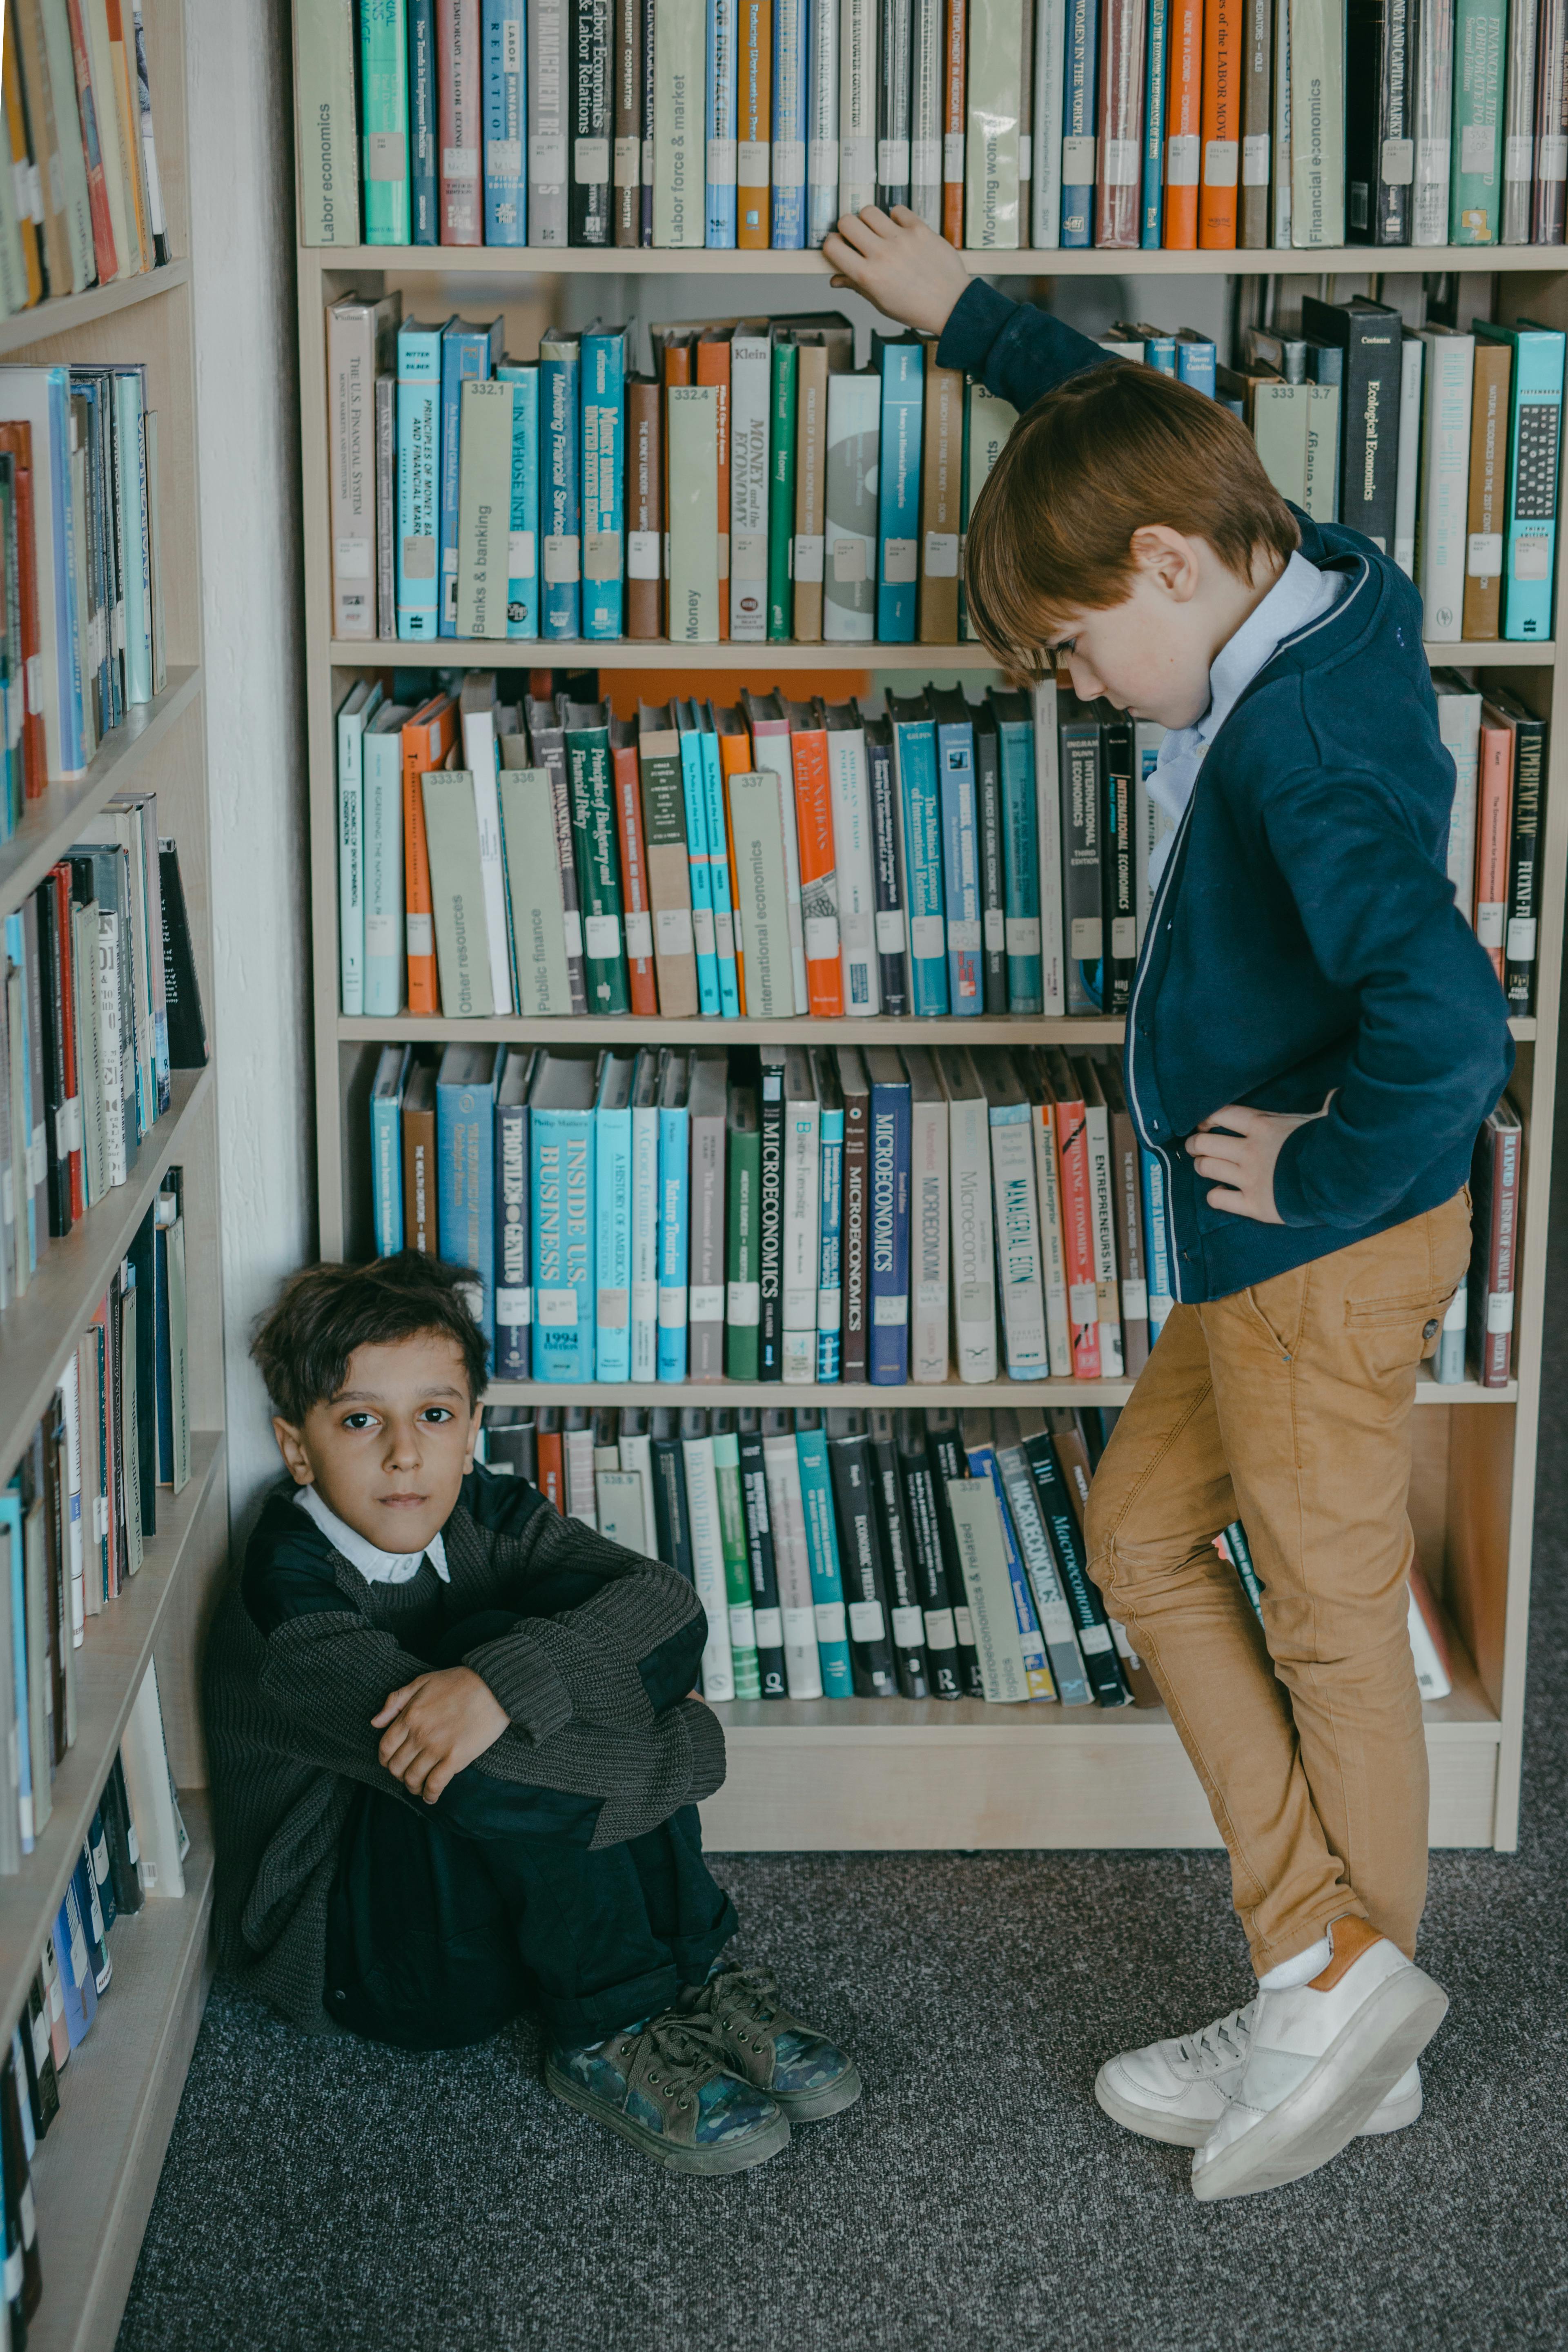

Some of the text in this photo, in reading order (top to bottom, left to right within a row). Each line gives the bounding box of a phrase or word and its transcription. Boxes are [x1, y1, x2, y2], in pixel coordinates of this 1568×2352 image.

[416, 20, 425, 38] New
[417, 40, 425, 67] Trends
[1074, 0, 1085, 86] WOMEN IN THE
[1182, 55, 1191, 82] CROWD
[1184, 37, 1191, 46] IN
[1391, 25, 1405, 94] AND CAPITAL
[1463, 17, 1474, 91] Second Edition
[1473, 17, 1487, 100] CORPORATE
[1487, 17, 1500, 92] FINANCIAL
[415, 78, 425, 125] Employment
[578, 15, 592, 134] Labor Relations
[592, 47, 607, 128] Economics
[624, 49, 633, 109] COOPERATION
[852, 19, 860, 128] MANPOWER CONNECTION
[317, 103, 334, 242] Labor economics
[418, 126, 426, 158] Practices
[670, 75, 685, 243] Labor force & market
[1308, 78, 1322, 243] Financial economics
[982, 179, 999, 246] Working
[471, 383, 504, 396] 332.1
[674, 389, 709, 401] 332.4
[735, 349, 767, 361] Klein
[1271, 388, 1295, 399] 333
[1443, 353, 1465, 388] HEAVEN
[351, 357, 363, 516] THE U.S. FINANCIAL SYSTEM
[512, 406, 525, 488] IN WHOSE
[550, 373, 566, 487] Marketing Financial
[584, 405, 599, 496] UNITED STATES
[1363, 380, 1380, 501] Ecological Economics
[1441, 398, 1464, 431] UNDER
[1483, 385, 1497, 511] NATURAL RESOURCES FOR THE 21ST
[412, 418, 421, 501] AND FINANCIAL
[422, 399, 432, 517] PRINCIPLES OF MONEY,
[598, 407, 618, 512] MONEY BANKING
[734, 431, 748, 527] ECONOMY
[748, 418, 765, 528] MONEY and the
[775, 450, 787, 482] Money
[1439, 450, 1462, 474] FEET
[472, 505, 492, 634] Banks & banking
[686, 589, 702, 640] Money
[430, 773, 464, 785] 333.9
[572, 749, 589, 829] Financial Policy
[590, 747, 615, 885] Principles of Budgetary and
[742, 777, 764, 788] 337
[840, 749, 849, 802] POLITICS
[848, 749, 860, 852] AMERICAN TRADE
[1072, 760, 1083, 827] ECONOMICS
[1085, 760, 1095, 846] INTERNATIONAL
[554, 783, 573, 869] FINANCING STATE
[912, 800, 927, 869] International
[924, 795, 939, 910] The Political Economy
[1117, 779, 1129, 909] INTERNATIONAL ECONOMICS
[452, 894, 472, 1014] Other resources
[531, 908, 552, 1011] Public finance
[751, 839, 773, 1016] International economics
[639, 1125, 650, 1238] A CHOICE FULFILLED
[926, 1122, 936, 1171] Mansfield
[1149, 1164, 1162, 1206] STARTING
[502, 1117, 524, 1283] PROFILES GENIUS
[539, 1145, 560, 1281] BUSINESS
[566, 1139, 587, 1287] INSIDE U.S.
[614, 1153, 626, 1286] A HISTORY OF AMERICAN
[665, 1179, 680, 1275] Nature Tourism
[762, 1121, 780, 1298] MICROECONOMICS
[874, 1114, 894, 1272] MICROECONOMICS
[1004, 1179, 1034, 1250] MANAGERIAL
[1069, 1118, 1087, 1266] RETHINKING ECONOMICS
[1095, 1154, 1112, 1272] ENTREPRENEURS IN
[1152, 1217, 1165, 1252] LIMITED
[1498, 1135, 1516, 1278] BLACKFORD A HISTORY OF SMALL
[848, 1166, 862, 1332] MICROECONOMICS
[1154, 1253, 1169, 1294] LIABILITY
[546, 1332, 578, 1343] 1994
[689, 1452, 714, 1592] BEYOND THE LIMITS
[1009, 1480, 1062, 1604] MACROECONOMICS
[960, 1523, 1000, 1699] Macroeconomics & related
[1002, 1657, 1019, 1699] topics
